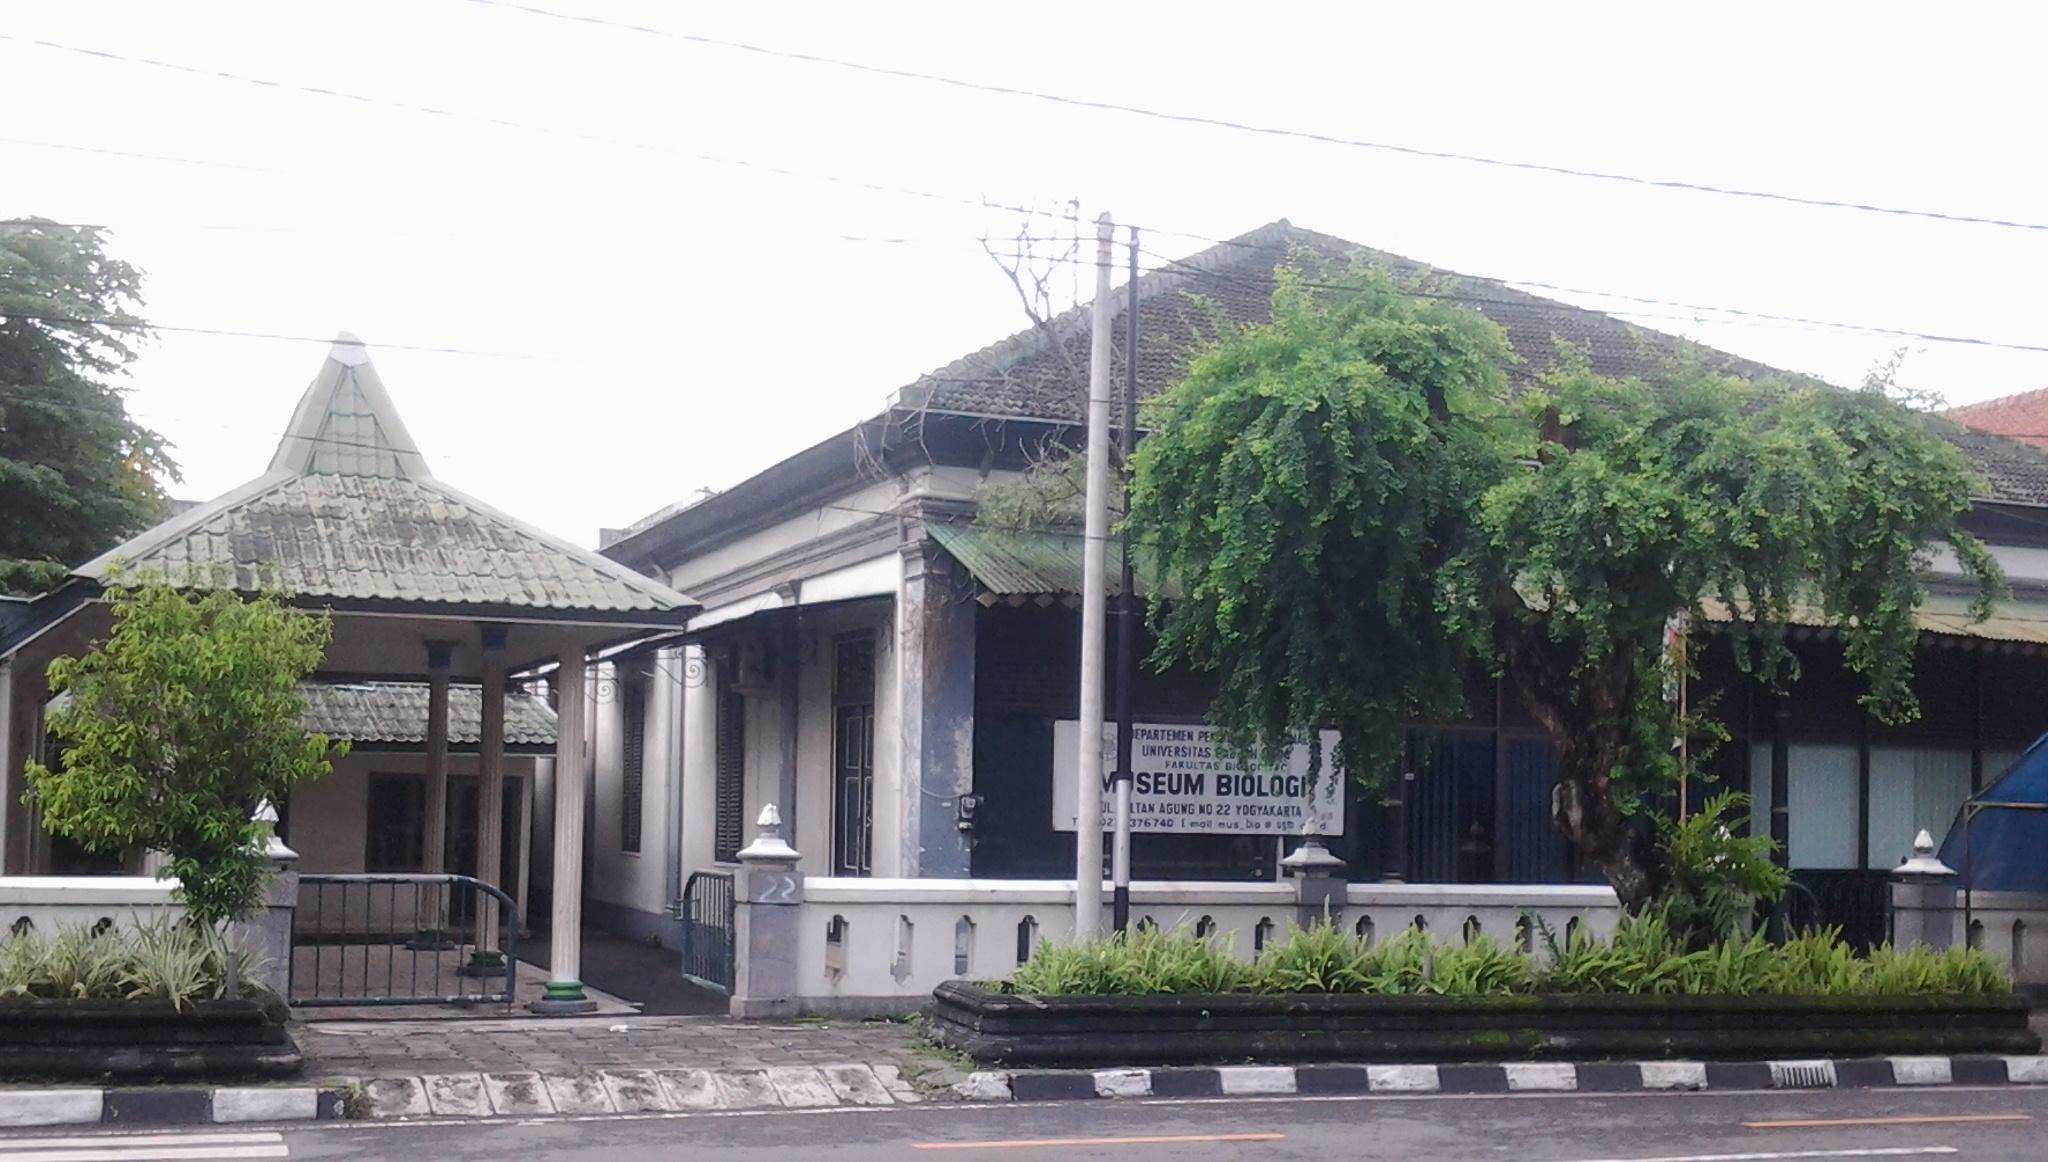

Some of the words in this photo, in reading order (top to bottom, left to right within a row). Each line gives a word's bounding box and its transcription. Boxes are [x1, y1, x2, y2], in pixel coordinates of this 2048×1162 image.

[1142, 744, 1212, 758] UNIVERSITAS
[1165, 760, 1220, 771] FAKULTAS
[1101, 772, 1205, 796] MSEUM
[1215, 774, 1307, 798] BIOLOGI
[1159, 802, 1195, 815] AGUNG
[1216, 804, 1231, 816] 22
[1235, 805, 1302, 817] YOGYAKARTA
